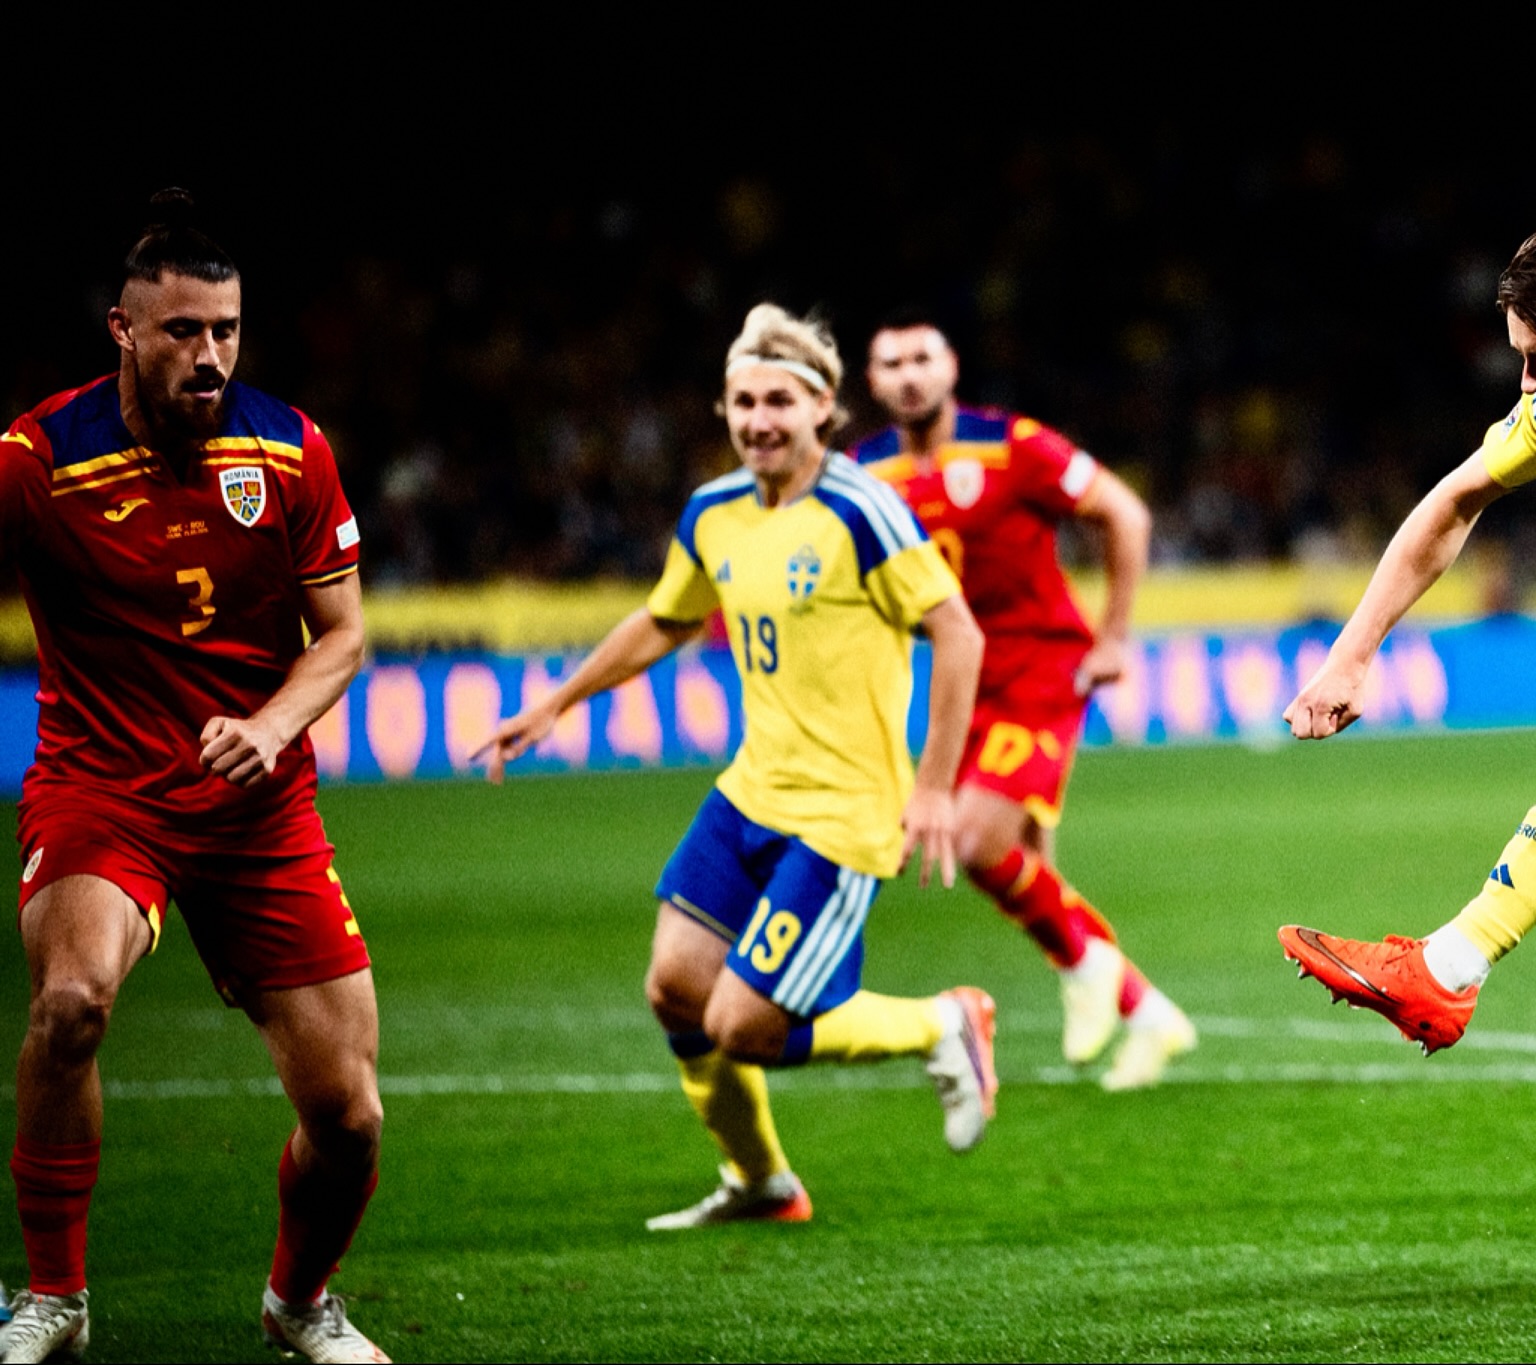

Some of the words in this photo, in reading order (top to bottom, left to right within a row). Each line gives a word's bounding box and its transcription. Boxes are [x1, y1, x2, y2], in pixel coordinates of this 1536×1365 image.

[176, 566, 216, 637] 3
[739, 613, 780, 674] 19
[737, 896, 801, 975] 19
